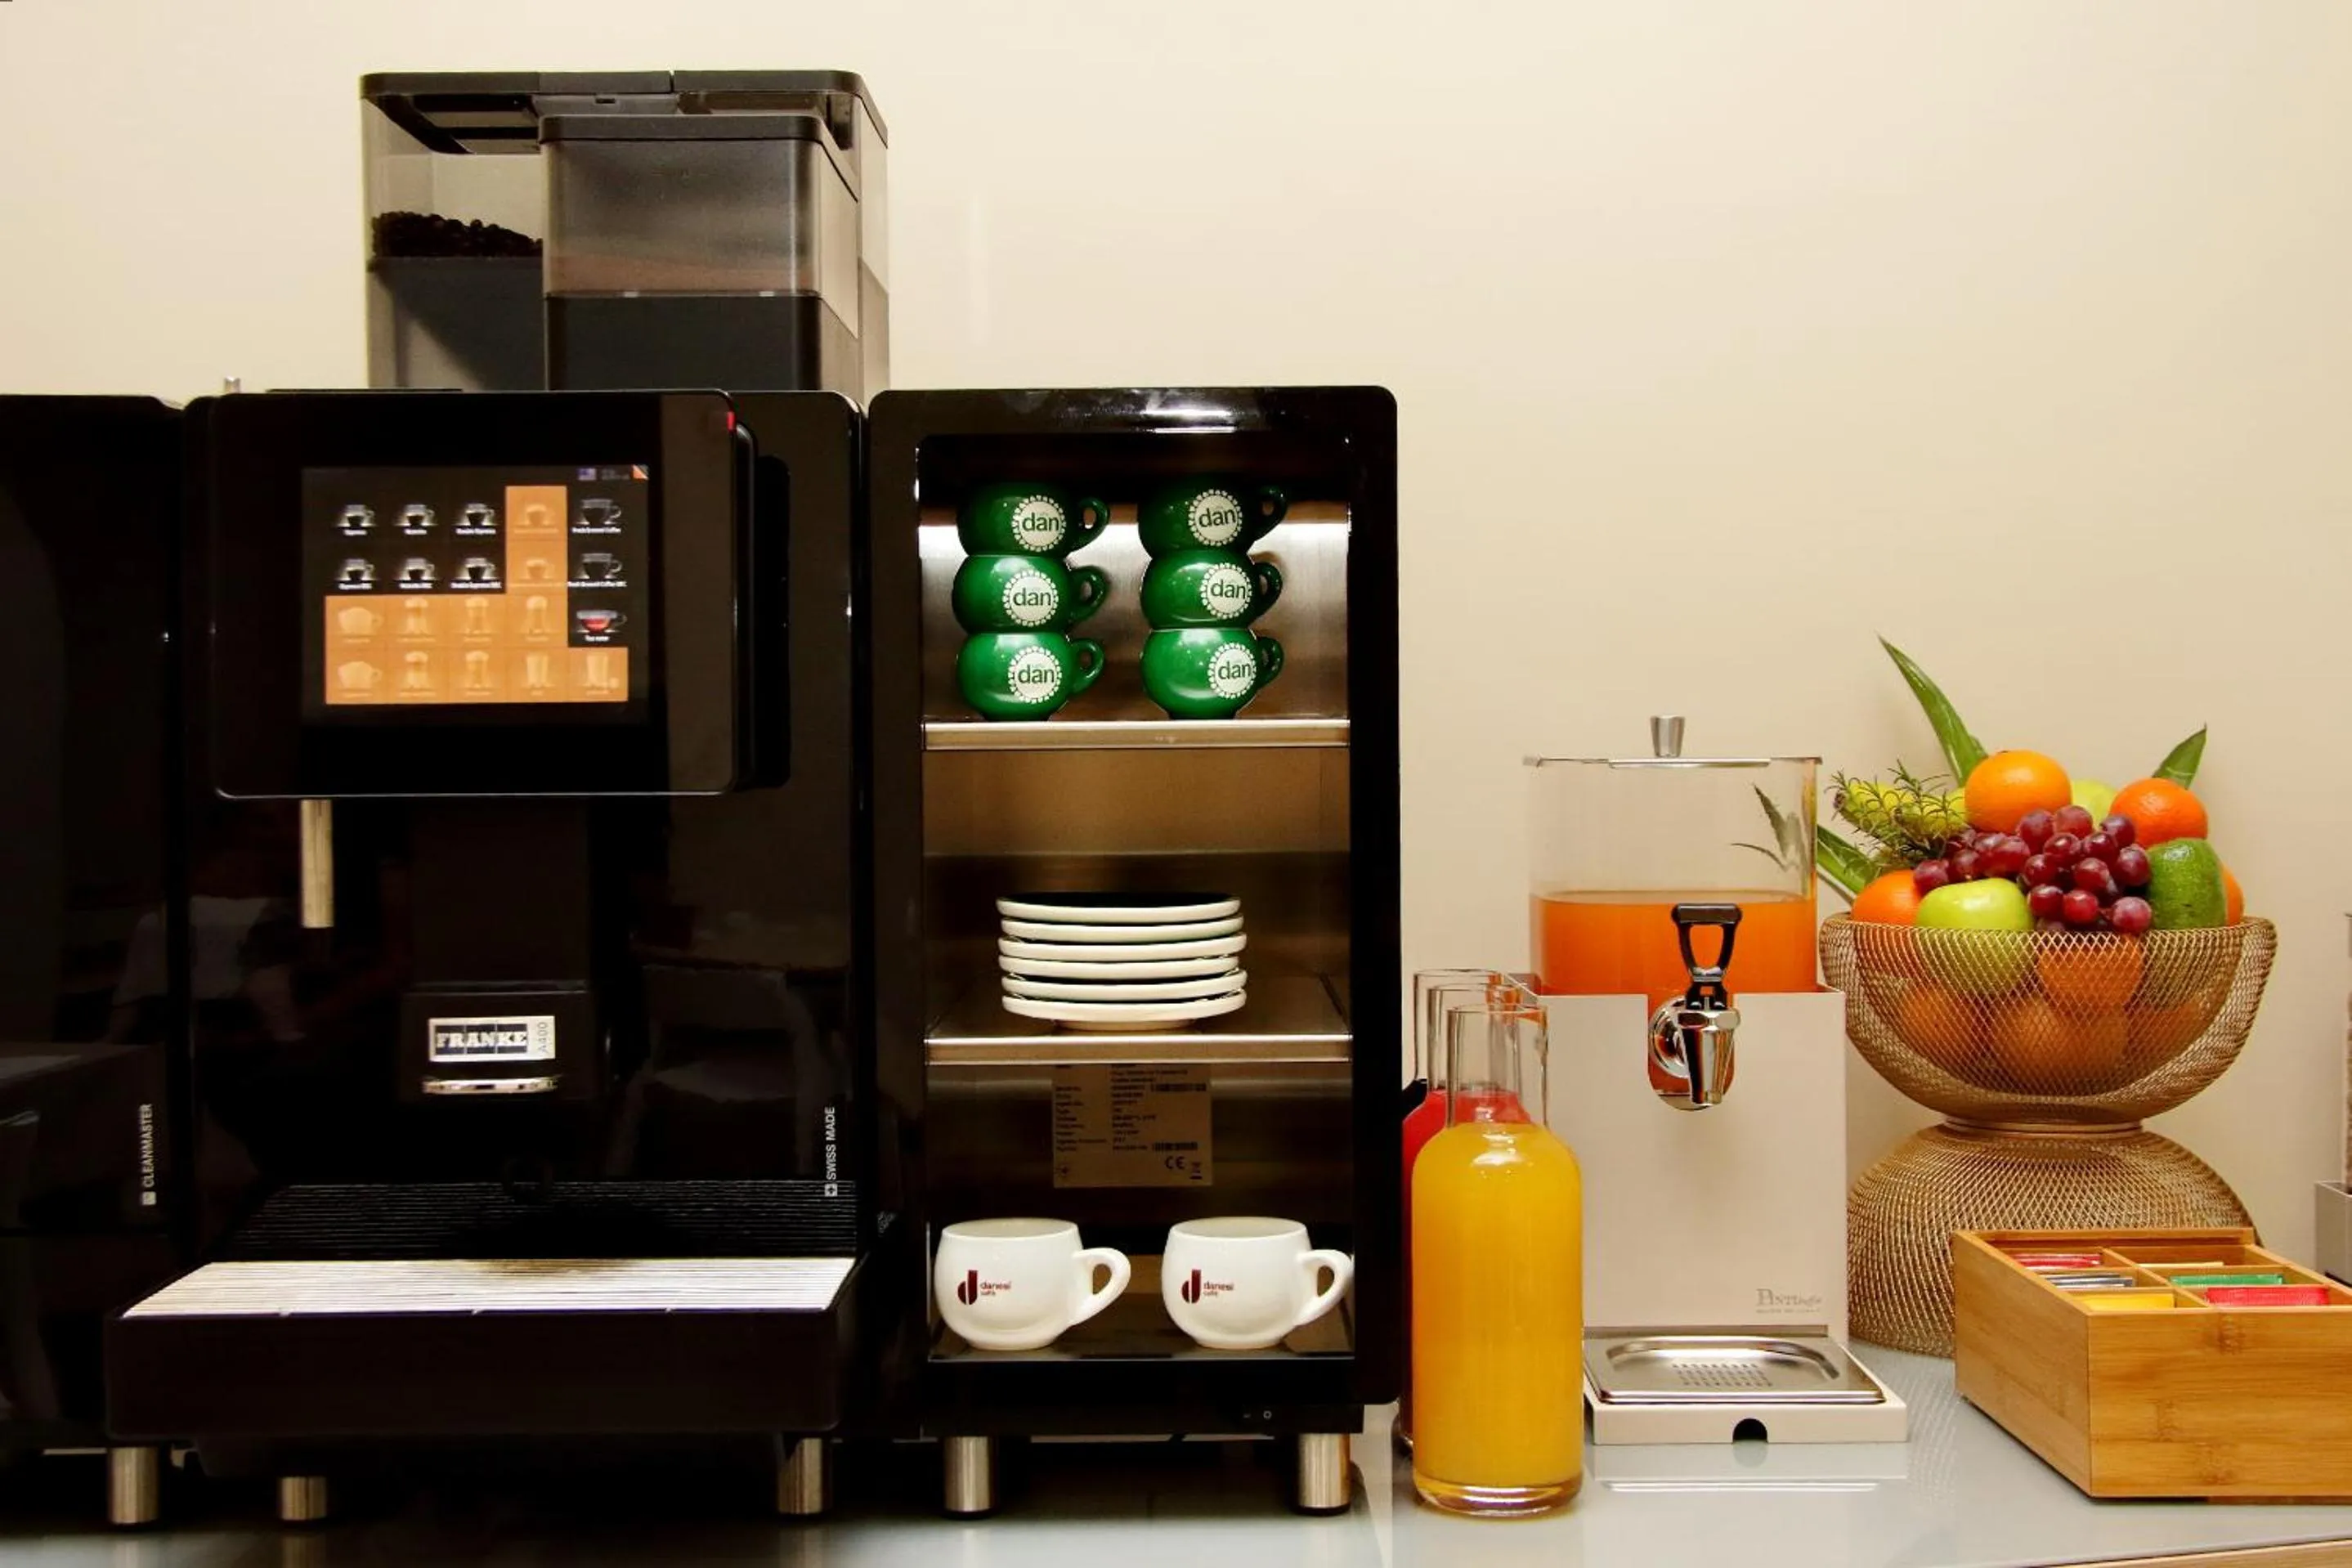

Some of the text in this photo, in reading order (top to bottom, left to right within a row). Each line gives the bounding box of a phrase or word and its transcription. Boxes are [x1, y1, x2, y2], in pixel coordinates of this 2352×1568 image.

[1022, 512, 1060, 531] dan
[1198, 507, 1236, 528] dan
[1014, 588, 1051, 606] dan
[1211, 579, 1246, 600] dan
[1018, 665, 1055, 683] dan
[1217, 661, 1252, 679] dan
[436, 1031, 527, 1049] FRANKE
[139, 1104, 155, 1188] CLEANMASTER
[824, 1106, 836, 1180] SWISS MADE
